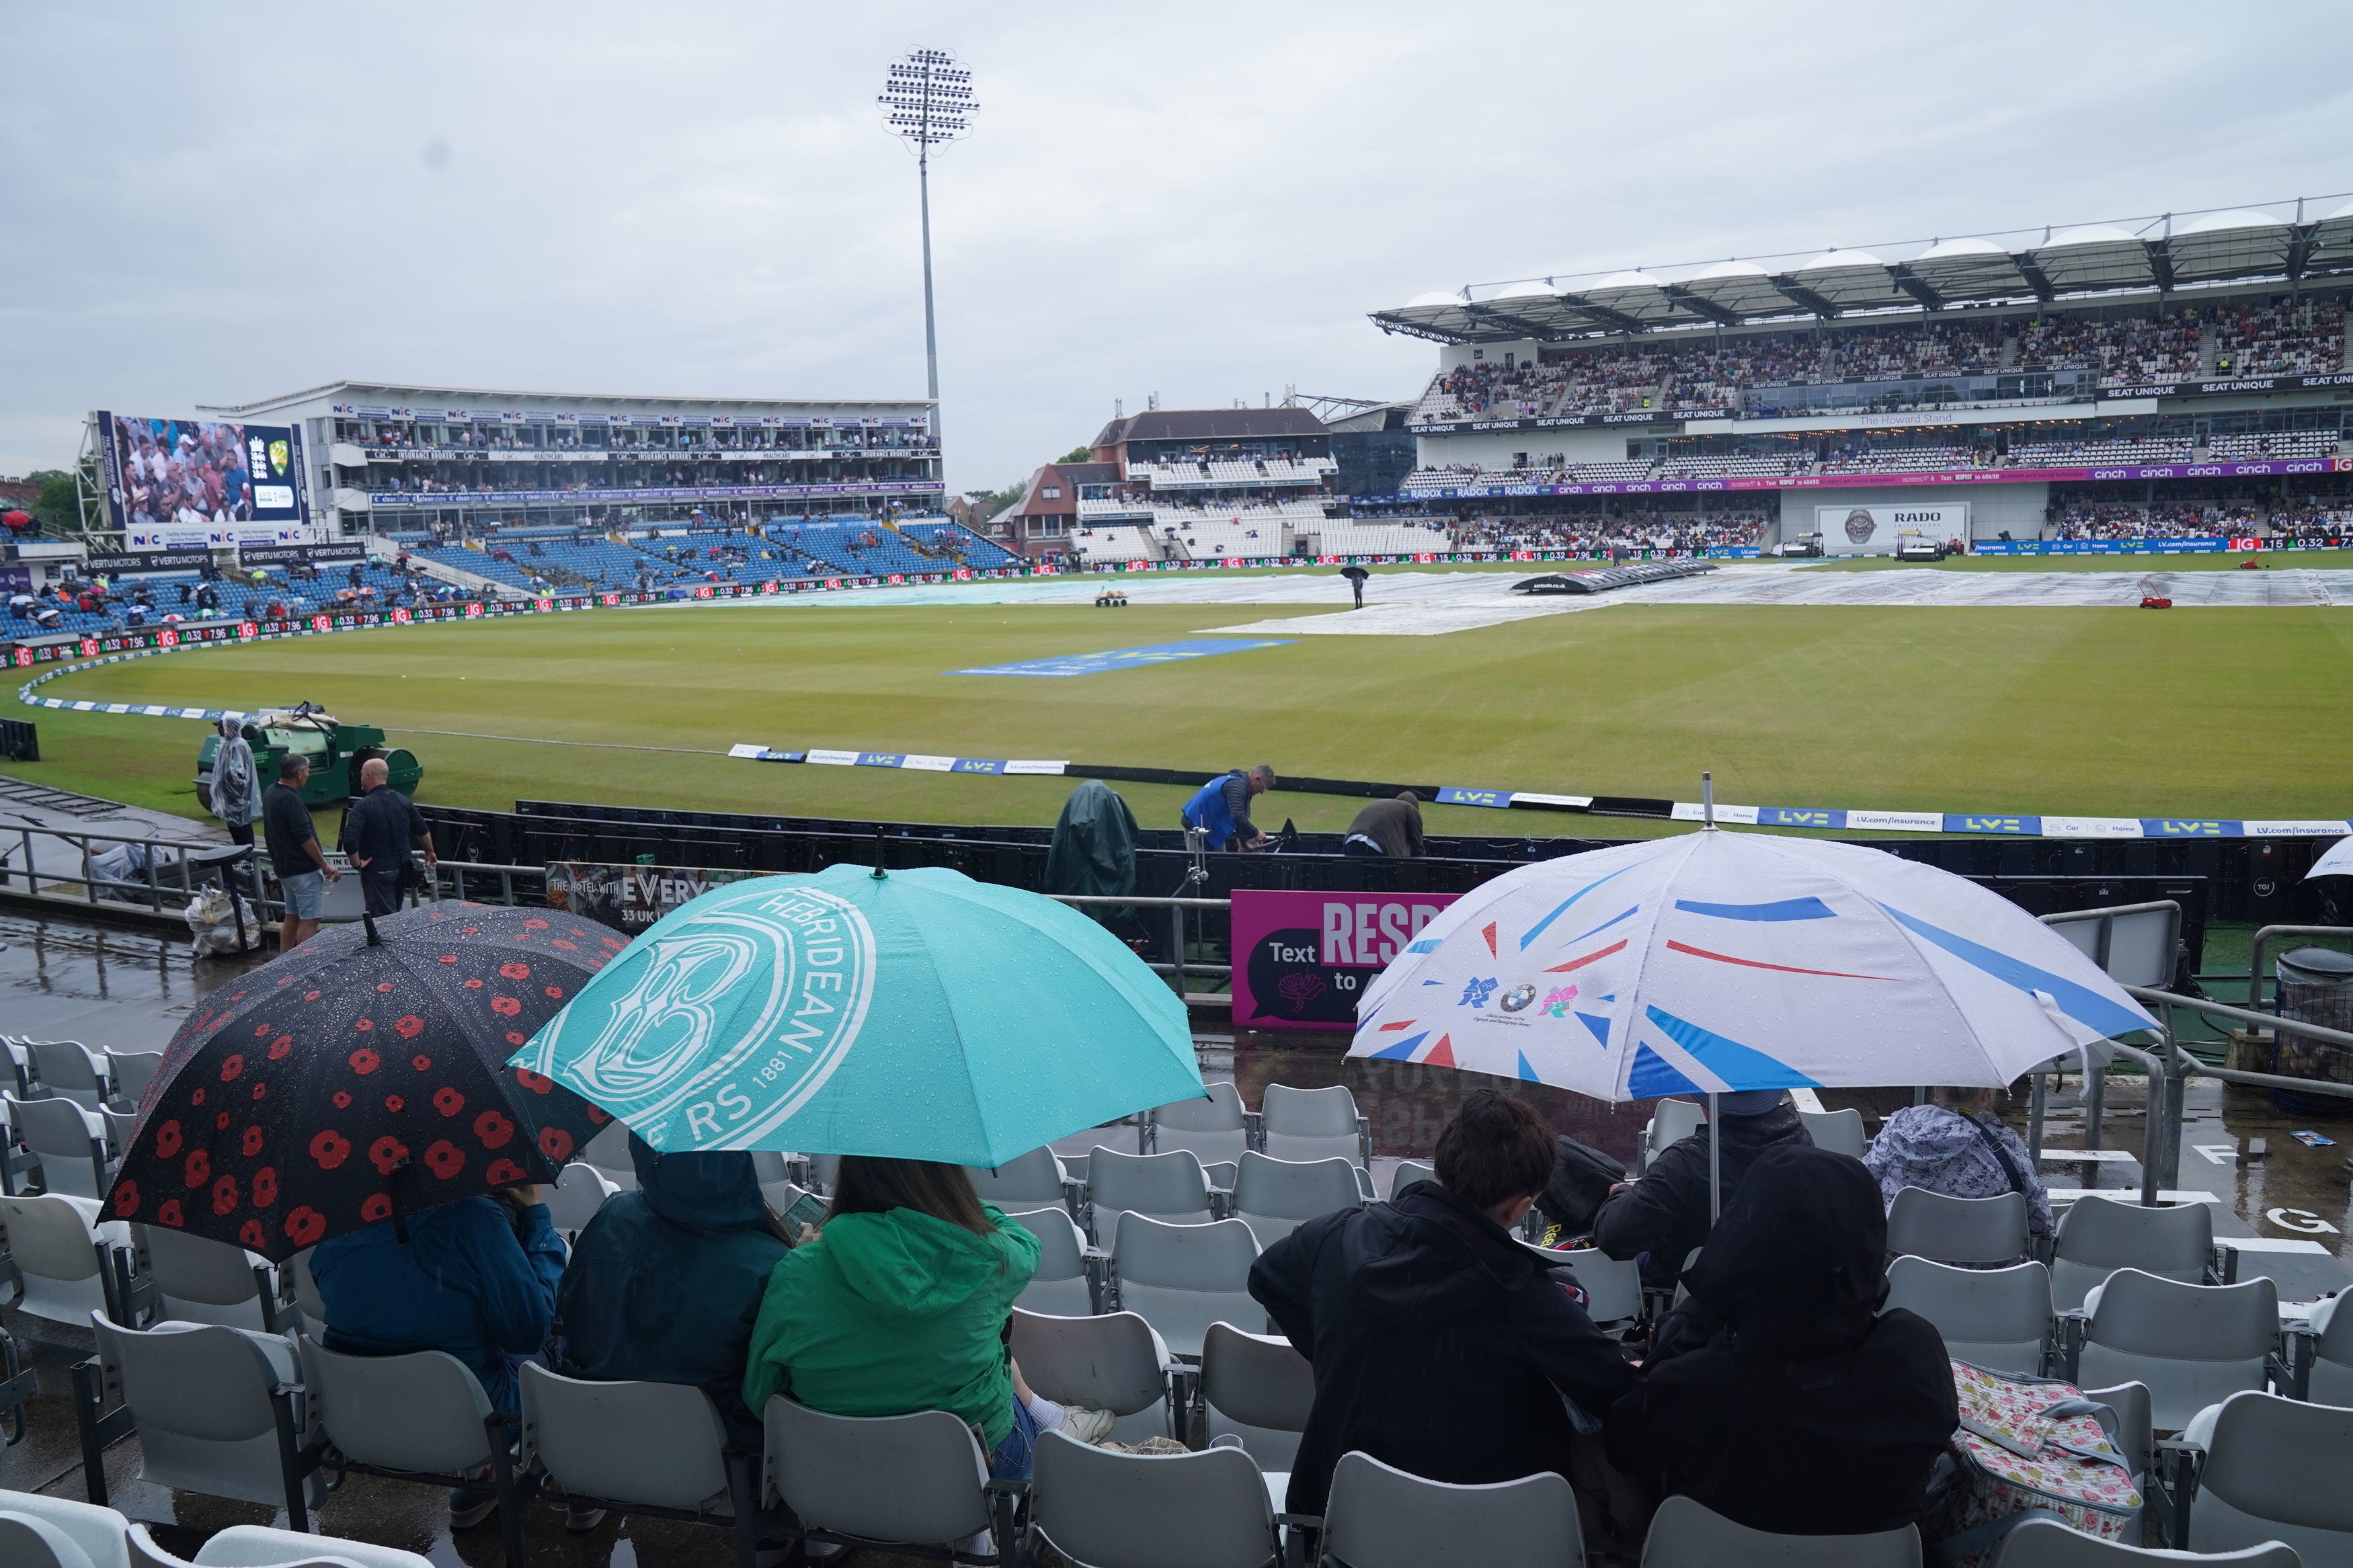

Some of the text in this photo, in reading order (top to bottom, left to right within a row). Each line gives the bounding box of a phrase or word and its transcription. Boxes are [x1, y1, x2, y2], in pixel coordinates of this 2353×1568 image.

[2202, 380, 2274, 393] SEAT UNIQUE
[2303, 378, 2329, 386] SEAT
[2108, 386, 2175, 397] SEAT UNIQUE
[1624, 414, 1654, 422] UNIQUE
[1860, 413, 1952, 425] The Howard Stand
[1491, 421, 1519, 429] UNIQUE
[431, 452, 456, 460] BROKERS
[2188, 464, 2221, 476] cinch
[2286, 461, 2322, 472] cinch
[2334, 459, 2352, 471] IG
[2095, 468, 2126, 479] cinch
[1505, 486, 1538, 495] RADOX
[1559, 485, 1582, 494] cinch
[1627, 483, 1650, 492] cinch
[1697, 480, 1722, 490] cinch
[1412, 489, 1442, 499] RADOX
[1458, 488, 1488, 497] RADOX
[1895, 512, 1940, 522] RADO
[2237, 538, 2254, 549] IG
[2297, 539, 2323, 547] 0.32
[251, 550, 298, 561] VERTU MOTORS
[336, 547, 360, 555] MOTORS
[89, 558, 141, 569] VERTU MOTORS
[159, 556, 182, 565] VERTU
[1229, 559, 1240, 567] IG
[957, 570, 967, 579] IG
[491, 604, 503, 612] 0.32
[511, 602, 524, 611] 7.96
[164, 631, 175, 645] IG
[187, 629, 202, 642] 0.32
[210, 628, 226, 640] 7.96
[1856, 816, 1936, 827] LV.com/insurance
[2256, 827, 2345, 835] LV.com/insurance
[551, 879, 567, 892] THE
[571, 880, 596, 893] HOTEL
[598, 882, 619, 895] WITH
[622, 909, 635, 921] 33
[638, 910, 654, 923] UK
[1269, 942, 1316, 963] Text
[758, 894, 844, 1053] HEBRIDEAN
[1334, 972, 1356, 991] to
[752, 1050, 793, 1090] 1881
[2192, 1145, 2240, 1164] F
[2266, 1208, 2340, 1233] G
